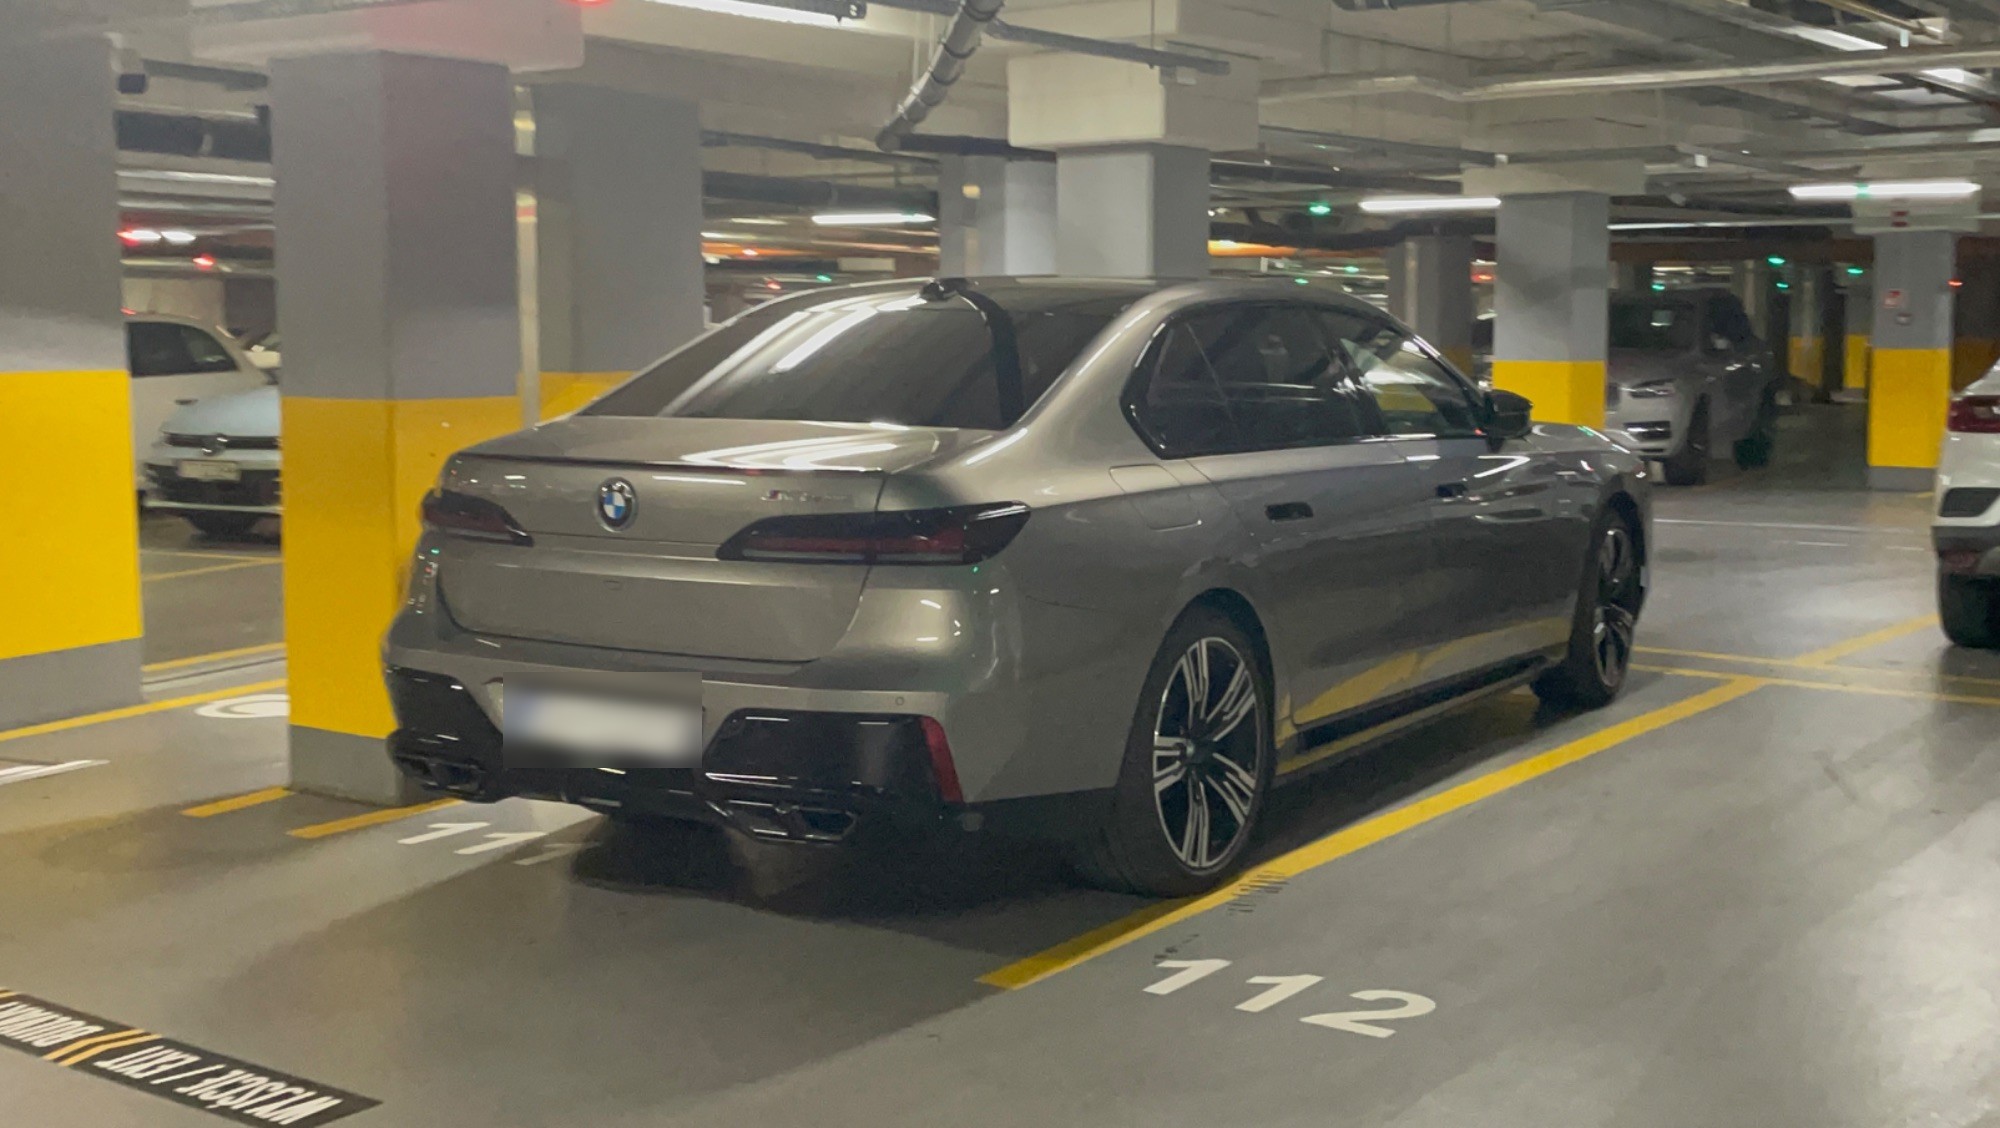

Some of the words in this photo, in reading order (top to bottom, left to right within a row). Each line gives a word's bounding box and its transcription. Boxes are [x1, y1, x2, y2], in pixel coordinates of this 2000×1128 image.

[1143, 959, 1437, 1038] 112
[93, 1044, 202, 1079] EXIT
[174, 1069, 344, 1126] WYJŚCIE
